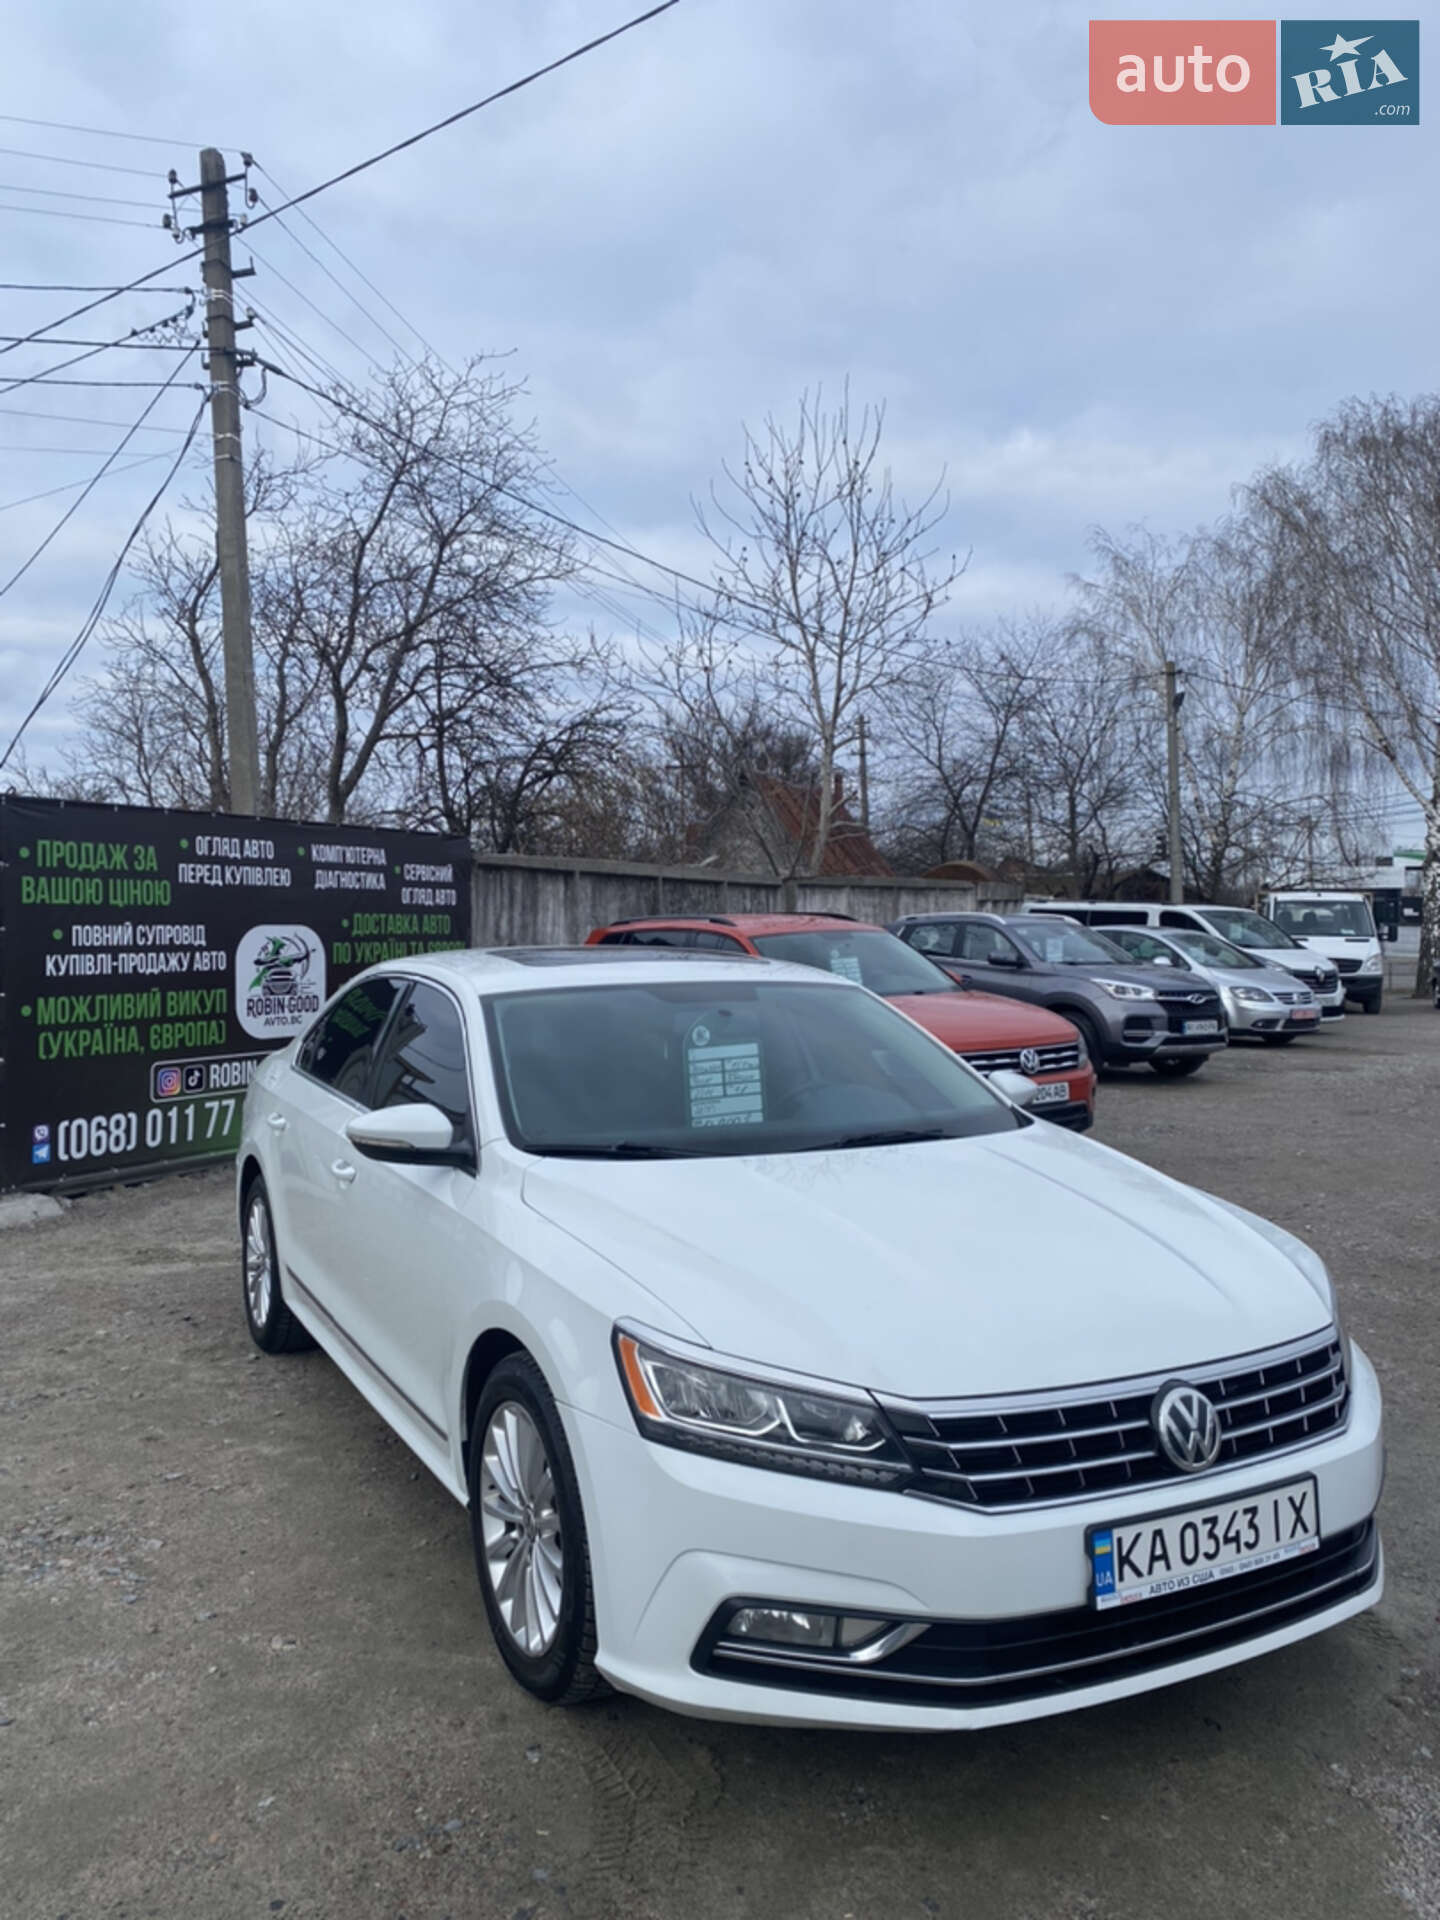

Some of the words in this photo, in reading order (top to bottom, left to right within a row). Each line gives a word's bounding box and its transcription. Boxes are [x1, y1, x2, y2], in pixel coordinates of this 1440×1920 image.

[37, 840, 128, 871] ПРОДАЖ
[133, 845, 157, 871] ЗА
[195, 836, 241, 859] ОГЛЯД
[243, 839, 275, 859] АВТО
[178, 863, 223, 886] ПЕРЕД
[224, 865, 292, 887] КУПІВЛЕЮ
[314, 870, 386, 890] ДІАГНОСТИКА
[403, 864, 453, 882] СЕРВІСНИЙ
[21, 876, 103, 905] ВАШОЮ
[109, 878, 171, 907] ЦІНОЮ
[401, 887, 434, 906] ОГЛЯД
[435, 889, 456, 906] АВТО
[72, 922, 133, 947] ПОВНИЙ
[136, 925, 206, 946] СУПРОВІД
[352, 913, 419, 936] ДОСТАВКА
[422, 914, 450, 935] АВТО
[45, 952, 190, 977] КУПІВЛІ-ПРОДАЖУ
[193, 951, 227, 972] АВТО
[333, 942, 351, 964] ПО
[37, 987, 161, 1025] МОЖЛИВИЙ
[166, 988, 227, 1017] ВИКУП
[246, 997, 285, 1018] ROBIN
[288, 995, 319, 1013] GOOD
[39, 1022, 144, 1060] (УКРАЇНА,
[150, 1020, 227, 1051] ЄВРОПА)
[57, 1112, 138, 1161] (068)
[146, 1103, 195, 1148] 011
[204, 1098, 236, 1139] 77
[1116, 1528, 1172, 1583] KA
[1179, 1505, 1260, 1567] 0343
[1273, 1491, 1309, 1543] IX
[1096, 1572, 1113, 1588] UA
[1150, 1579, 1176, 1596] АВТО
[1192, 1569, 1216, 1586] США
